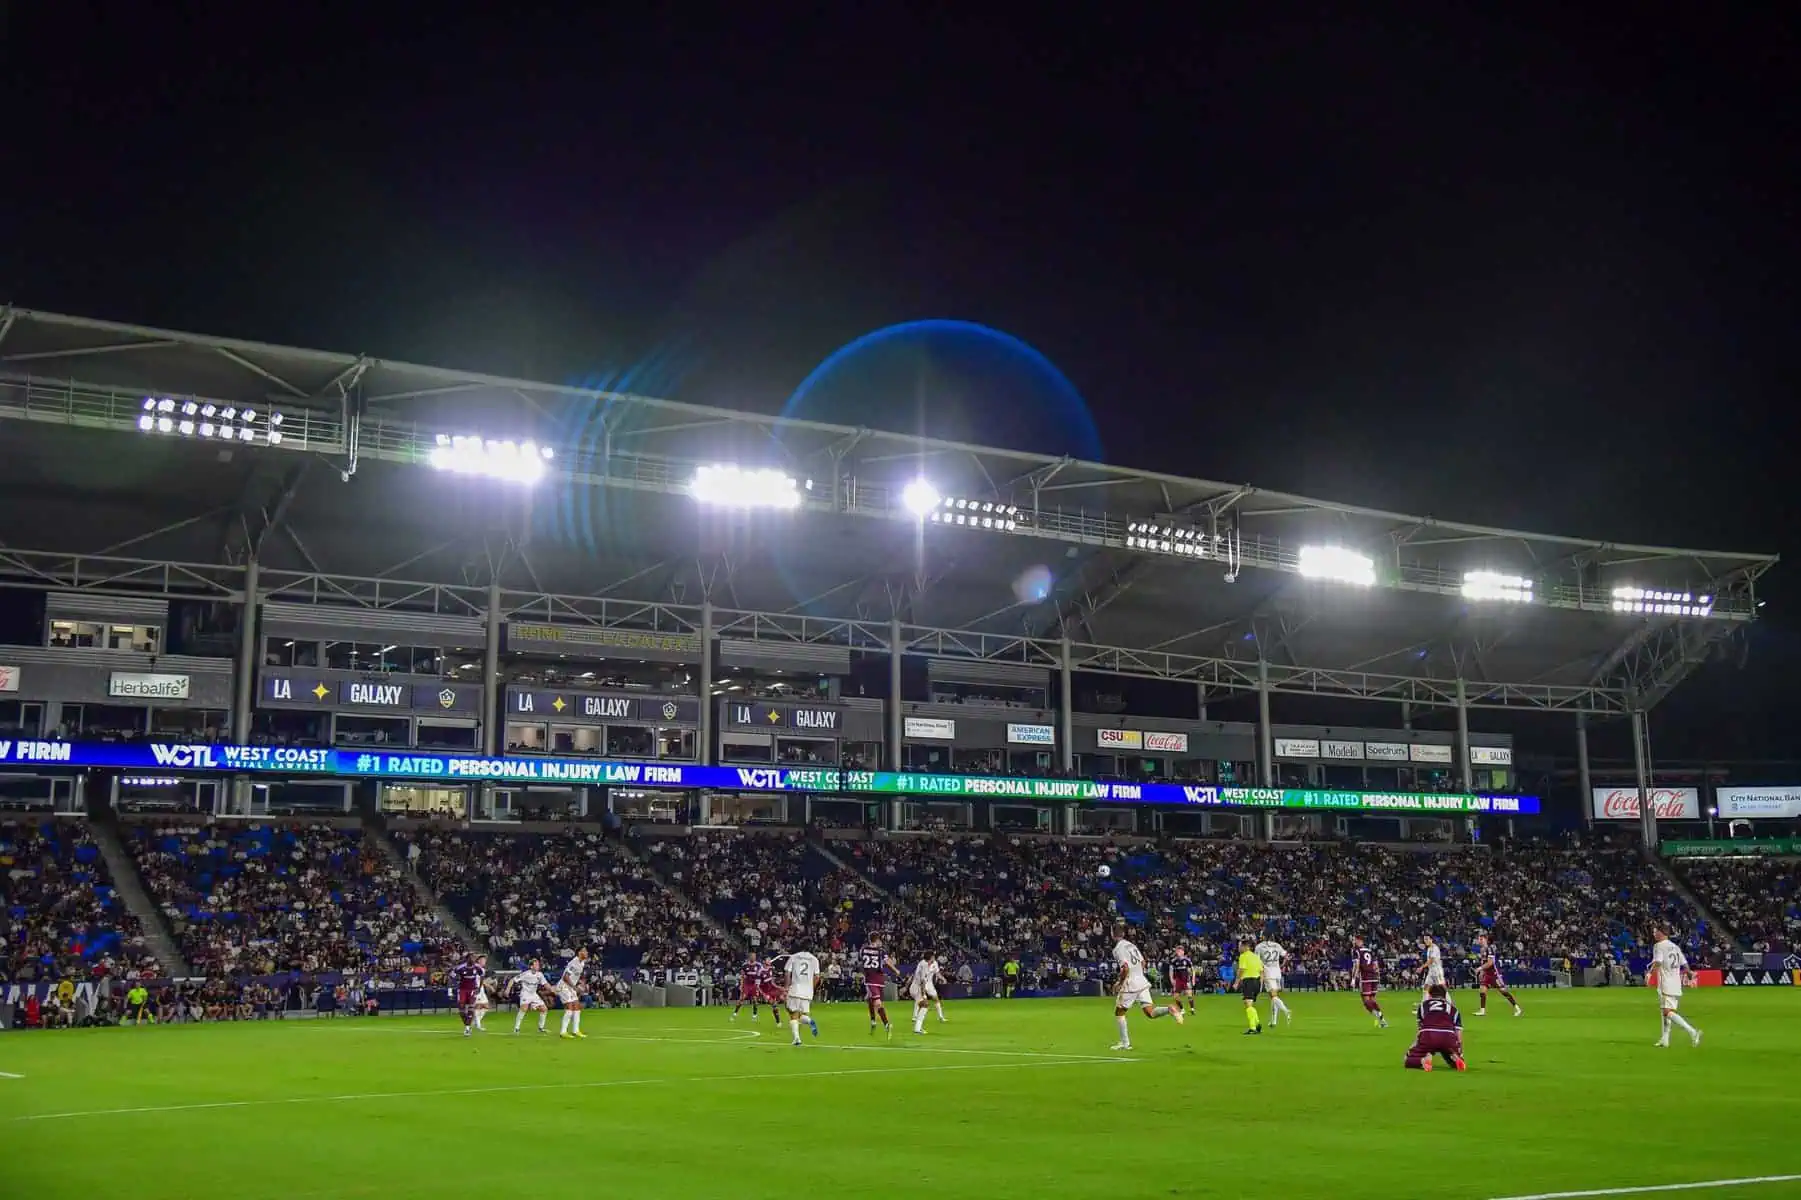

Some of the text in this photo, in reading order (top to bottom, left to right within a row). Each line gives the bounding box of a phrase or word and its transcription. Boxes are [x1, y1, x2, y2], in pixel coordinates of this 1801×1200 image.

[113, 680, 181, 696] Herbalife
[274, 680, 403, 704] LA GALAXY
[518, 694, 630, 717] LA GALAXY
[737, 706, 836, 729] LA GALAXY
[1011, 726, 1050, 734] AMERICAN
[1016, 734, 1051, 742] EXPRESS
[16, 741, 71, 760] FIRM
[150, 744, 218, 767] WCTL
[224, 746, 328, 763] WEST COAST
[1328, 744, 1357, 757] Modelo
[1490, 752, 1510, 761] GALAXY
[227, 761, 326, 771] TRIAL LAWYERS
[356, 754, 682, 783] #1 RATED PERSONAL INJURY LAW FIRM
[737, 768, 785, 789] WCTL
[789, 770, 822, 783] WEST
[896, 775, 1142, 800] #1 RATED PERSONAL INJURY LAW FIRM
[1183, 786, 1222, 804] WCTL
[1223, 788, 1285, 801] WEST COAST
[1303, 791, 1520, 811] #1 RATED PERSONAL INJURY LAW FIRM
[1603, 790, 1685, 817] Cocaola
[862, 954, 880, 968] 23
[1263, 950, 1279, 962] 22
[1363, 951, 1372, 965] 9
[1668, 952, 1680, 969] 21
[800, 962, 809, 976] 2
